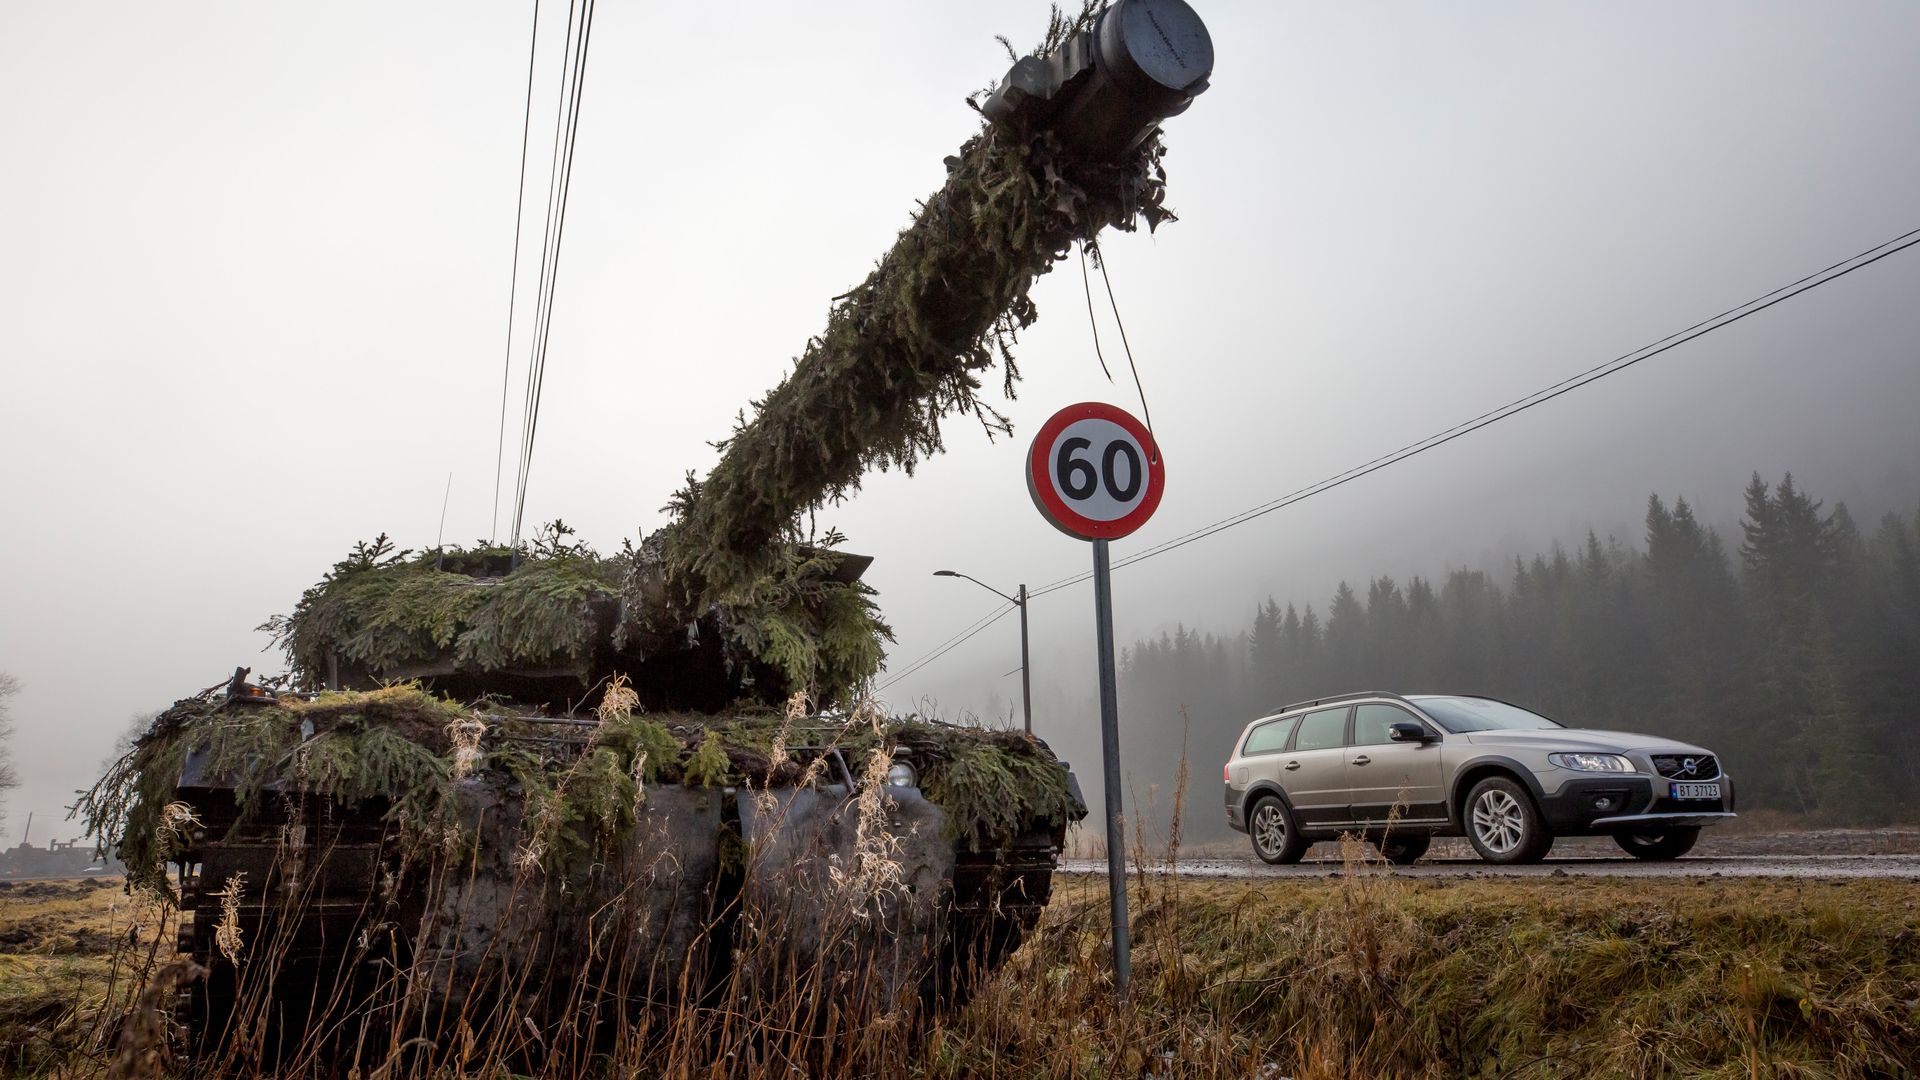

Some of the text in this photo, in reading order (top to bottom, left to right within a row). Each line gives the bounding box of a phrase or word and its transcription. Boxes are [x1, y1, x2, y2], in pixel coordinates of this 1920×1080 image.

[1057, 436, 1142, 503] 60
[1680, 785, 1718, 797] BT 37123
